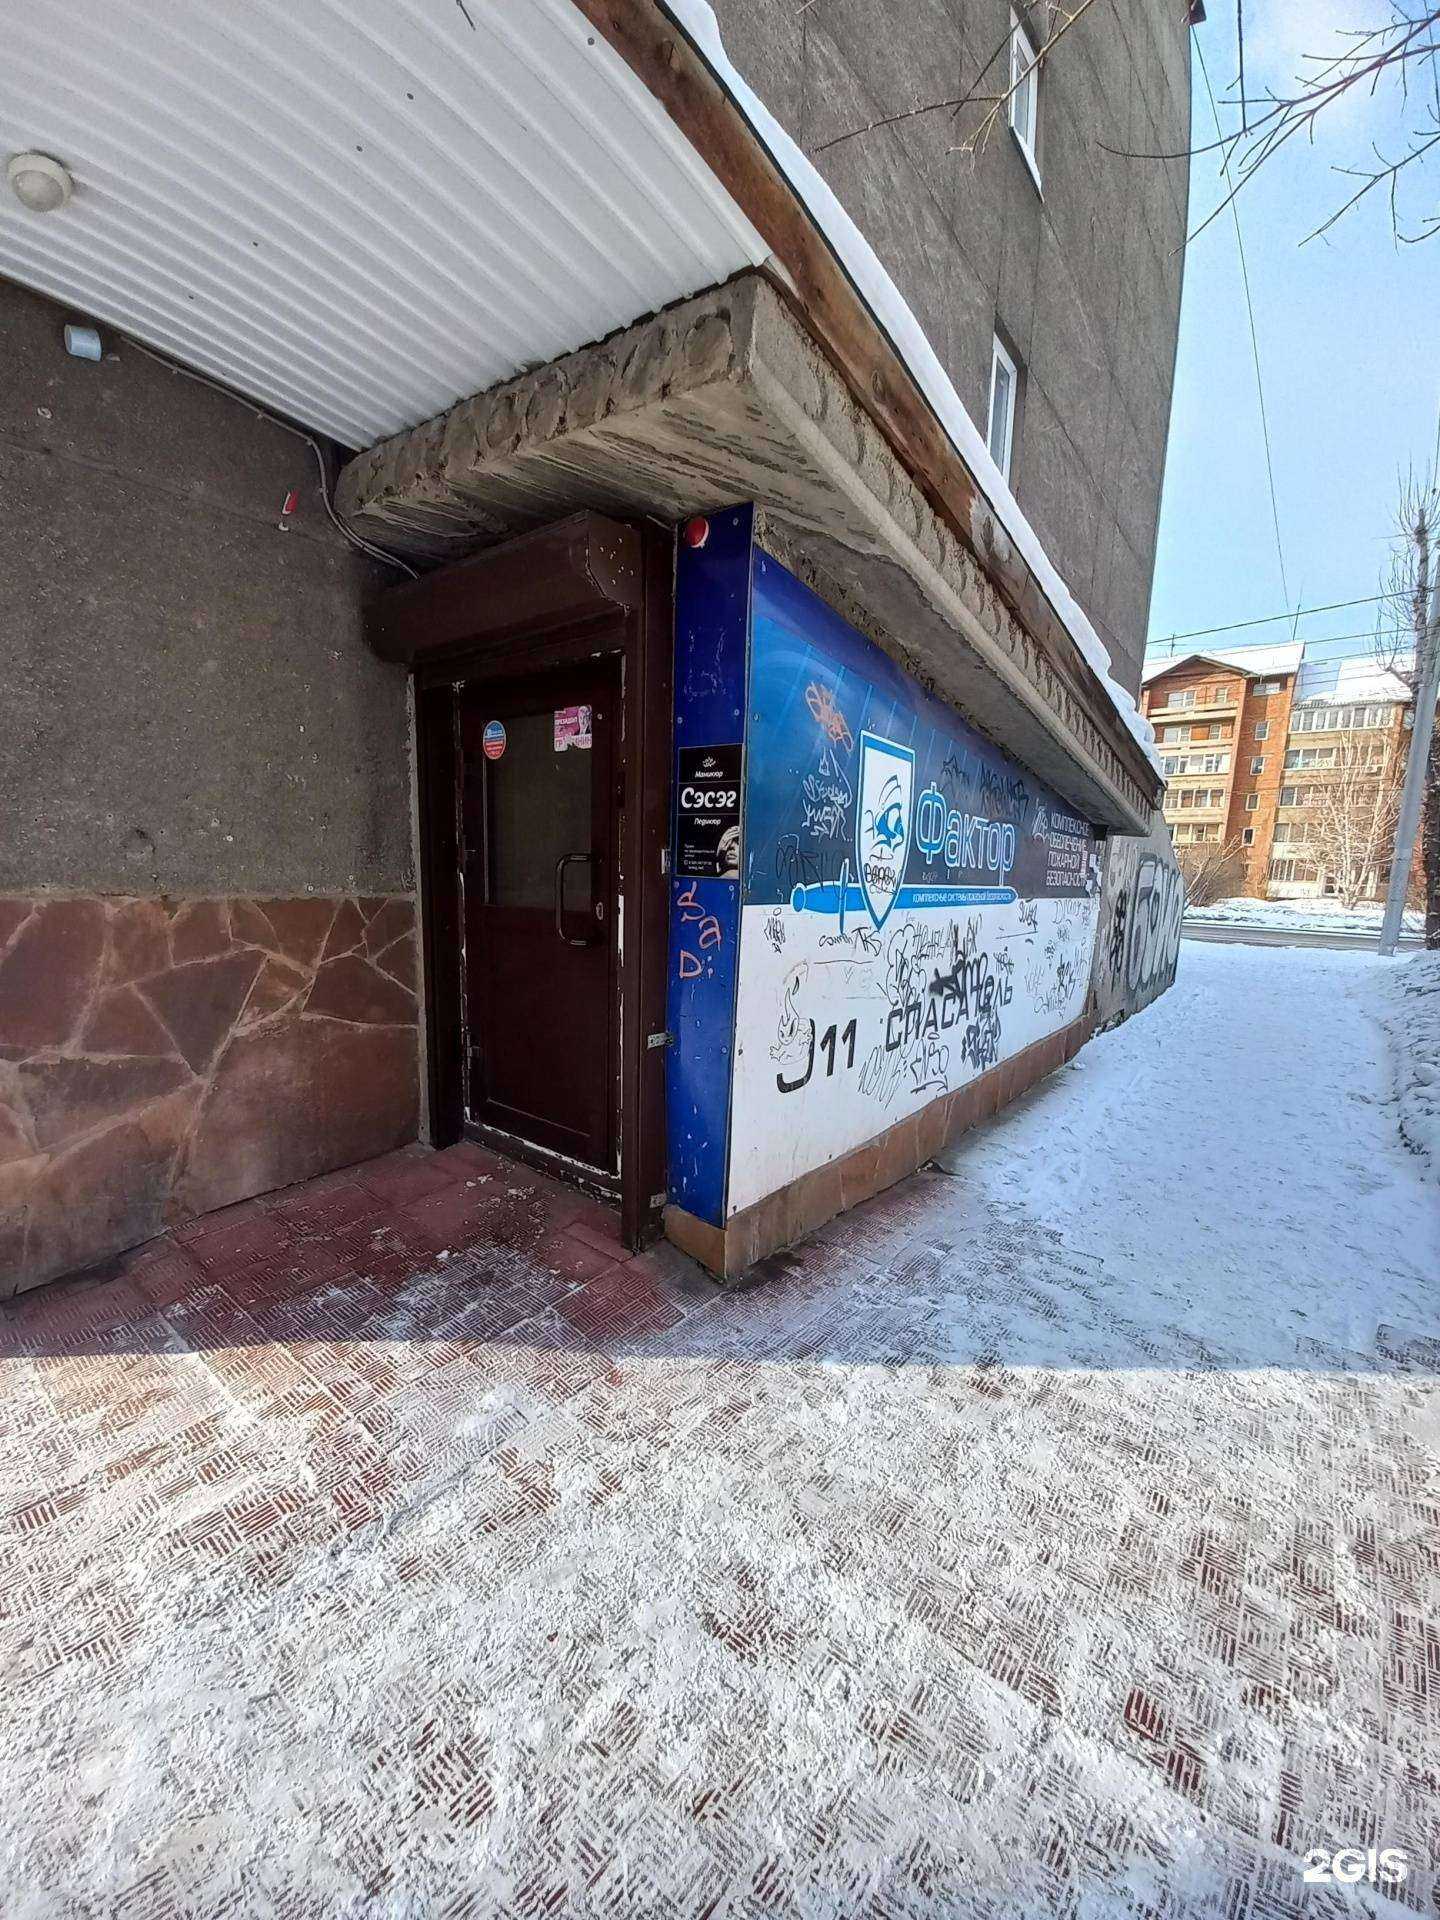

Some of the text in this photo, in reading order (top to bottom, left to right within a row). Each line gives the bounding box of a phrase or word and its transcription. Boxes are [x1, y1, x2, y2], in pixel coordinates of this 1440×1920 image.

[694, 770, 723, 779] Маникюр
[681, 787, 737, 809] Сэсэг
[694, 817, 722, 827] Педикюр
[916, 782, 1016, 887] Фактор
